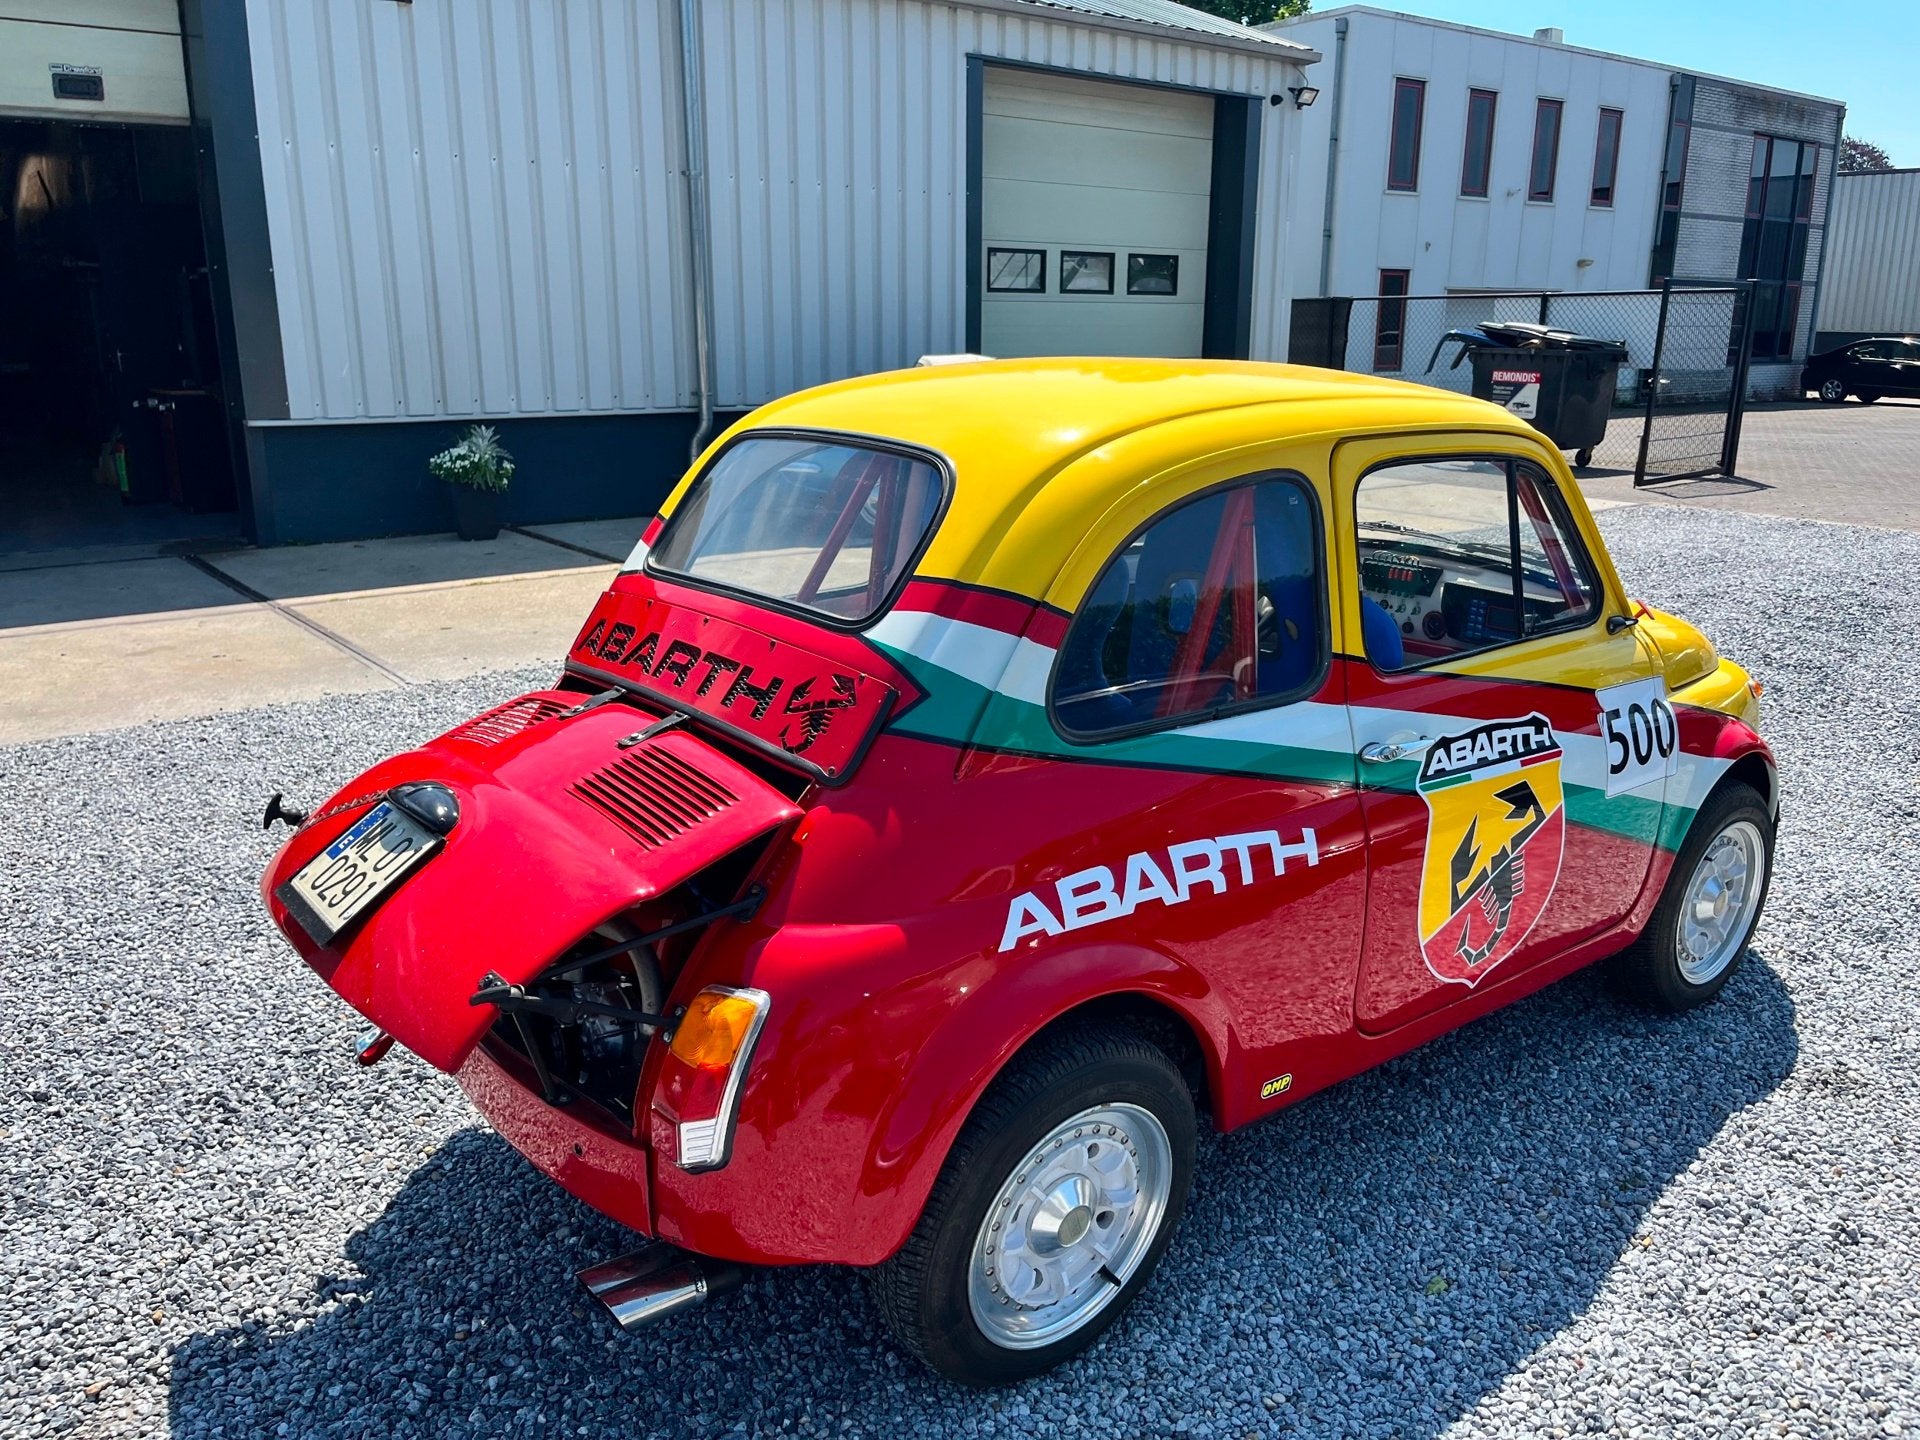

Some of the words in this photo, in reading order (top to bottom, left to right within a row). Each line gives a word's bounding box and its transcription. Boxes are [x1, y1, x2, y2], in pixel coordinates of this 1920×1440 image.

[576, 618, 784, 722] ABARTH
[1426, 726, 1551, 776] ABARTH
[1604, 698, 1676, 775] 500
[350, 817, 398, 863] ML
[311, 854, 378, 918] 0291
[998, 827, 1320, 953] ABARTH
[1263, 1076, 1290, 1097] OMP
